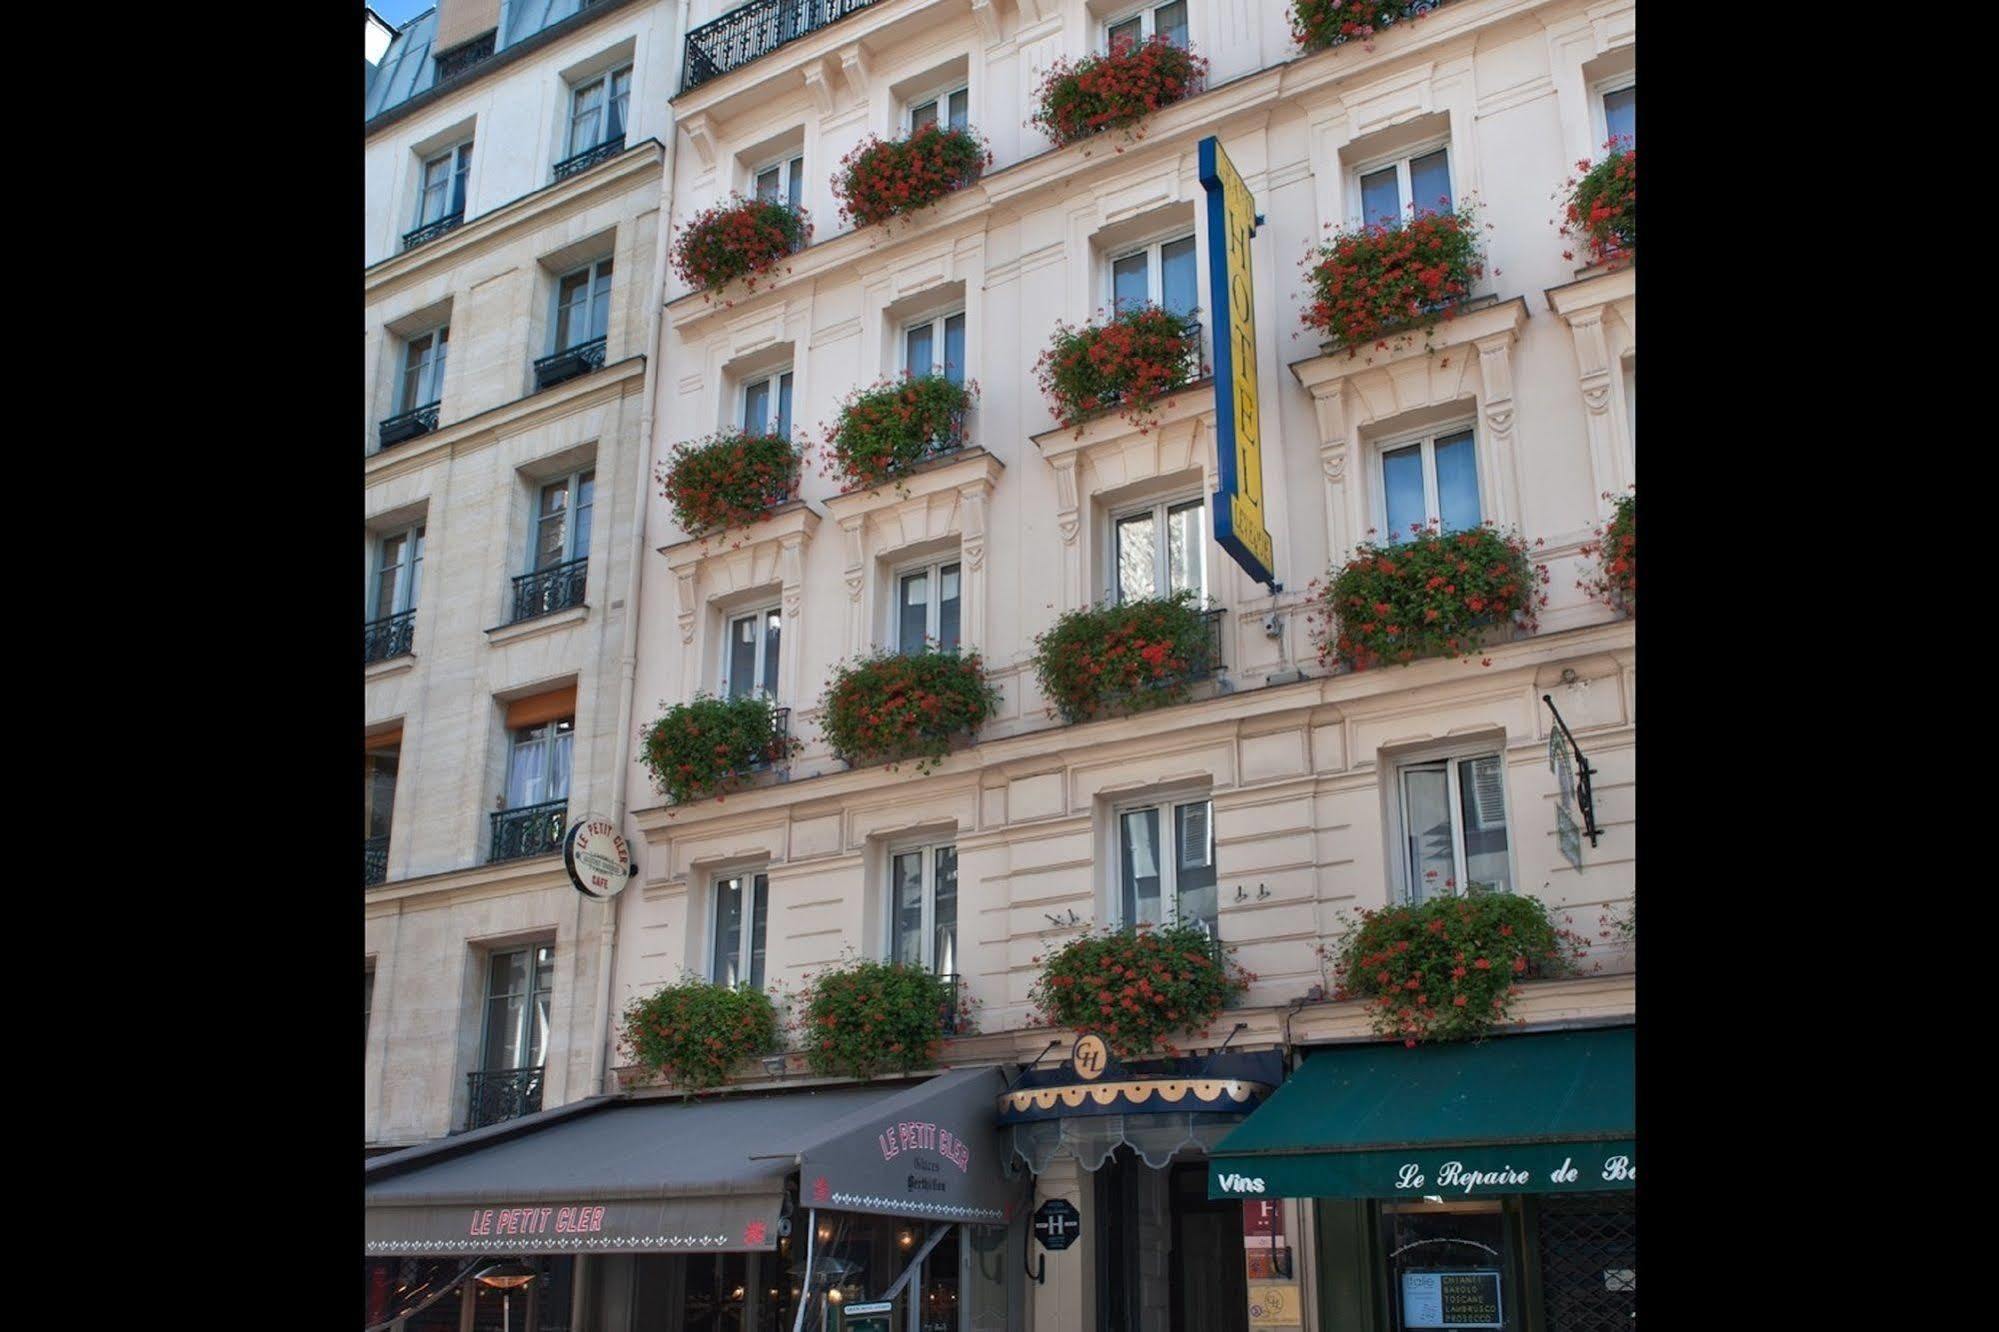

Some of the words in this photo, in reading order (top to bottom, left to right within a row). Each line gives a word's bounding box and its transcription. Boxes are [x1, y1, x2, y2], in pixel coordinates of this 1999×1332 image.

[1229, 209, 1258, 507] HOTEL
[577, 833, 589, 849] LE
[588, 822, 612, 836] PETIT
[613, 836, 628, 863] CLER
[879, 1126, 900, 1161] LE
[899, 1121, 936, 1150] PETIT
[940, 1129, 969, 1173] CLER
[1218, 1173, 1266, 1193] Vins
[1395, 1163, 1425, 1189] Le
[1436, 1160, 1530, 1194] Repaire
[1549, 1157, 1579, 1184] de
[470, 1210, 493, 1236] LE
[496, 1208, 553, 1235] PETIT
[555, 1206, 605, 1233] CLER
[1048, 1214, 1064, 1235] H
